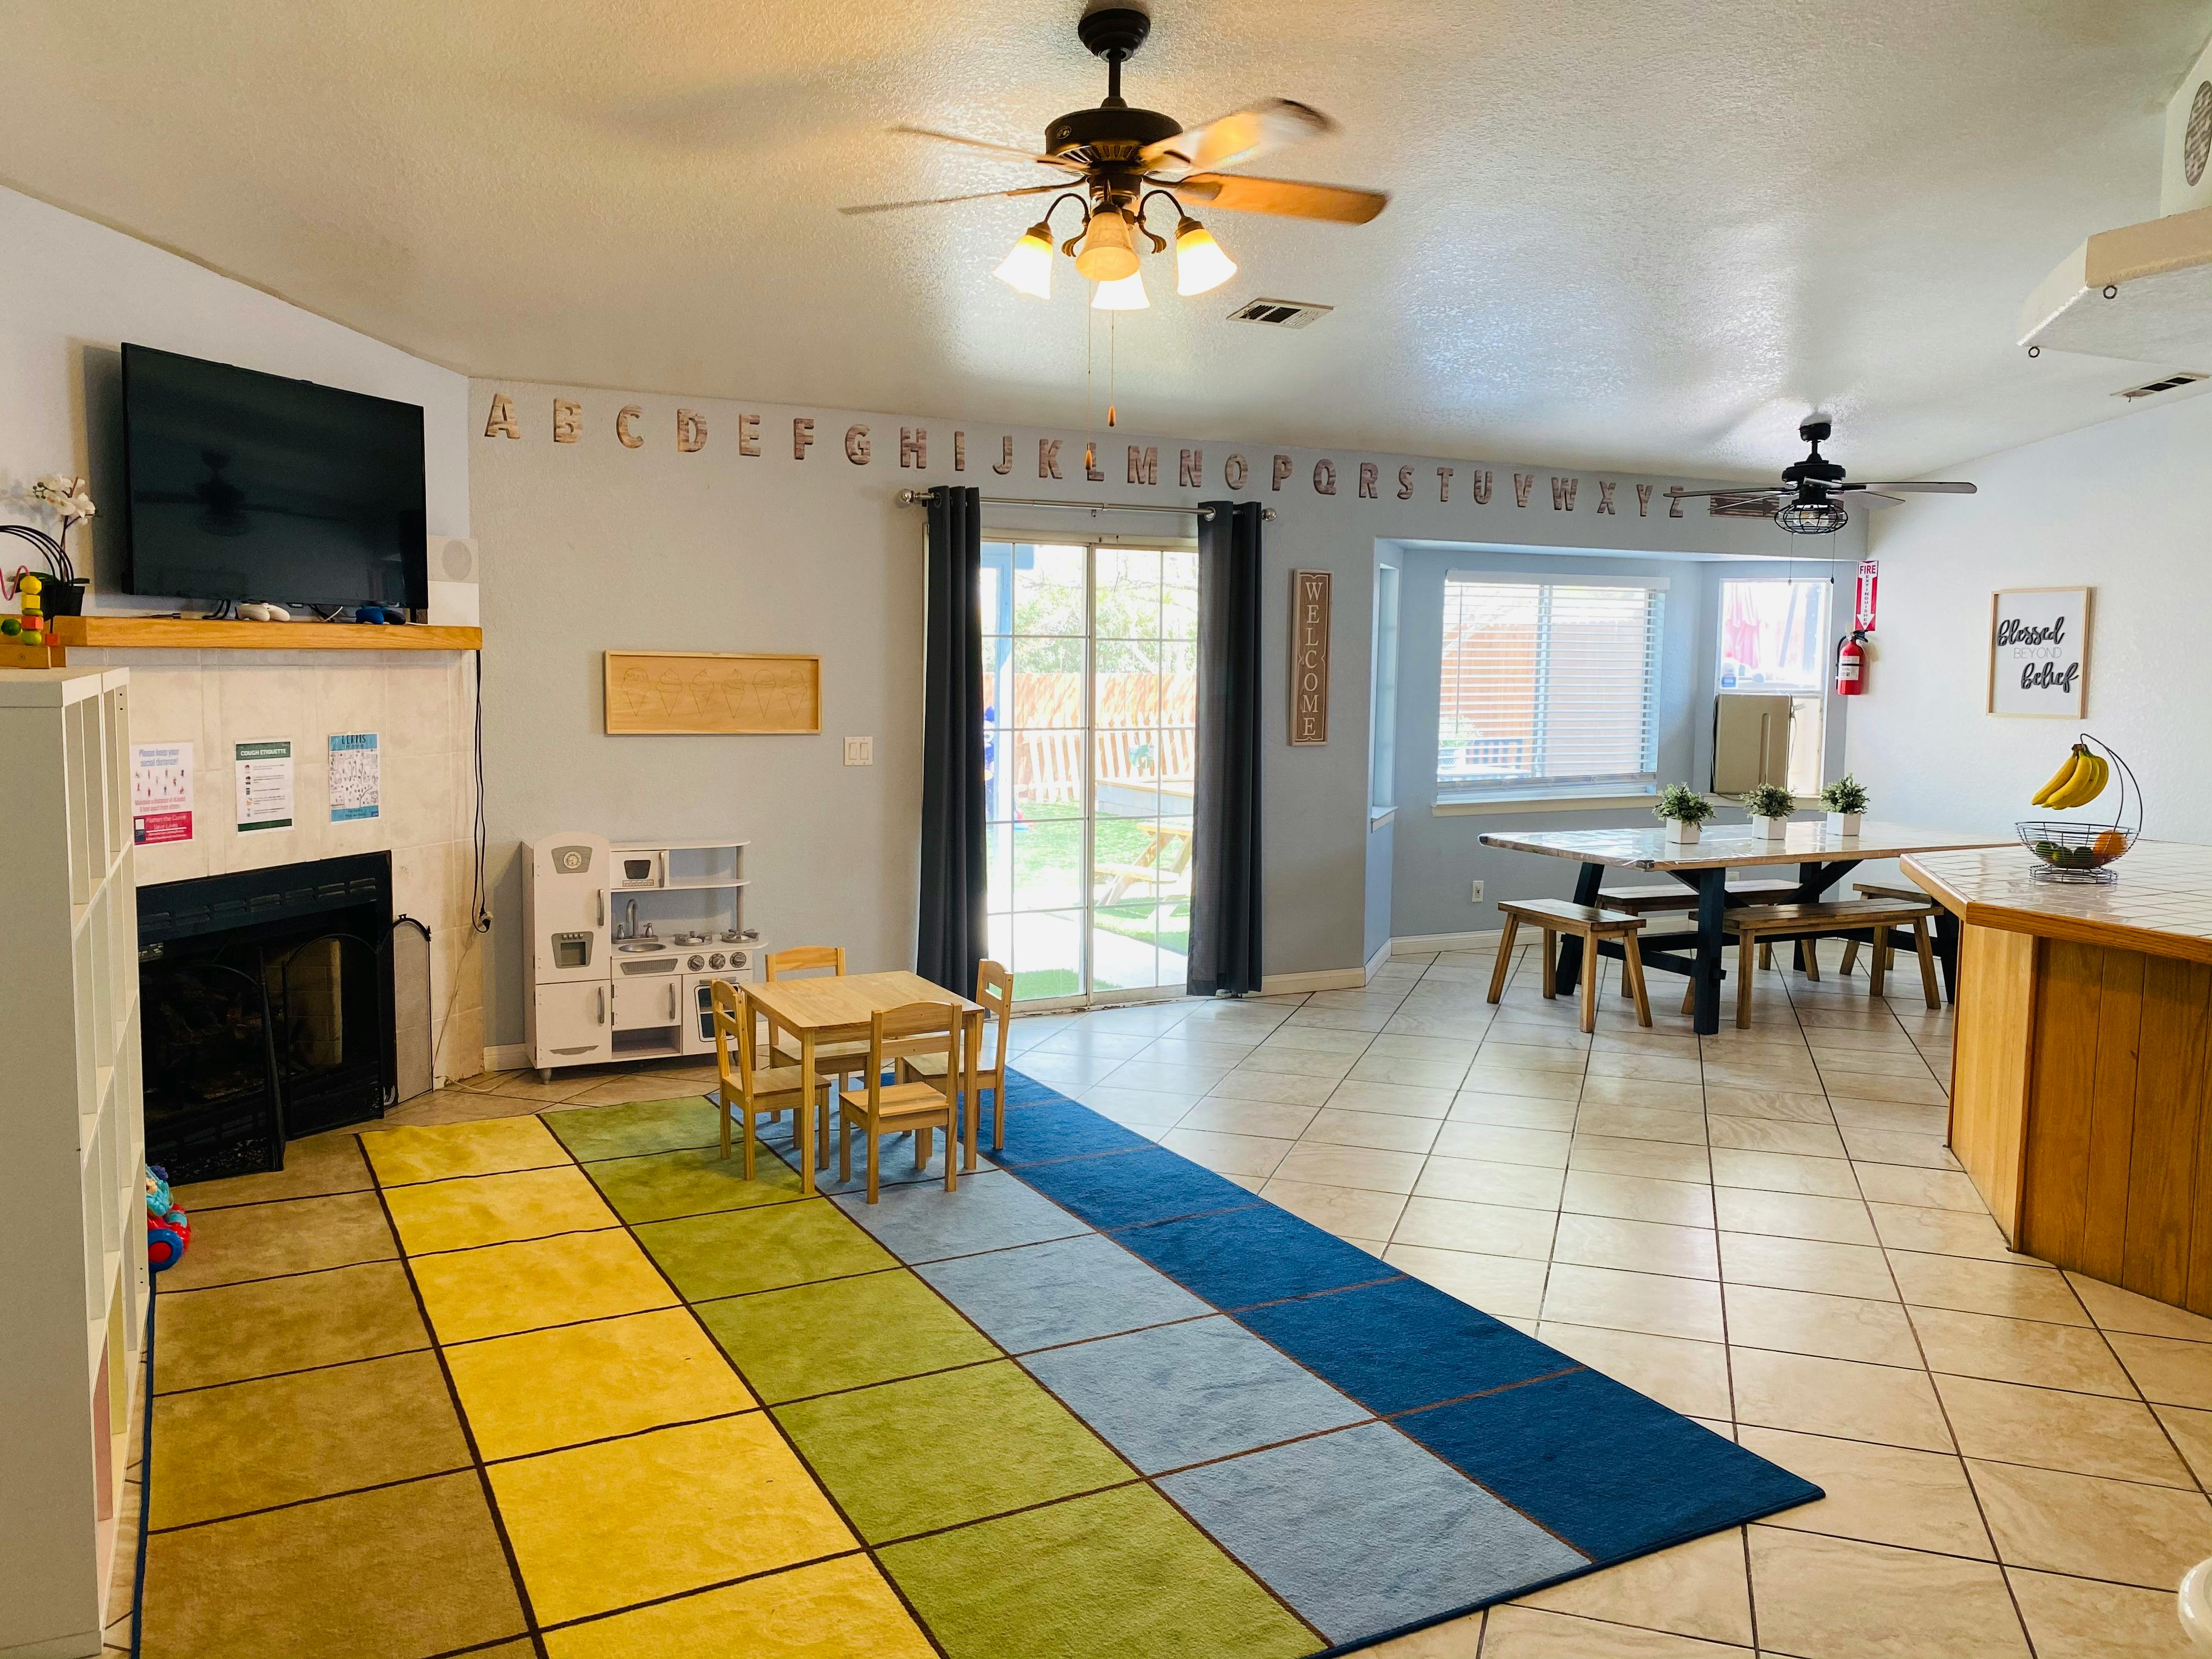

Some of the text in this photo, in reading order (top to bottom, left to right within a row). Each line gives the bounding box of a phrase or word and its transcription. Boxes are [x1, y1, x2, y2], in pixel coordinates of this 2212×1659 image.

[484, 393, 1684, 518] A B C D E F G H I J K L M N O P Q R S T U V W X Y Z
[1860, 565, 1876, 574] FIRE
[1302, 582, 1323, 736] WELCOME
[2013, 647, 2062, 659] BEYOND
[2021, 662, 2079, 693] belief
